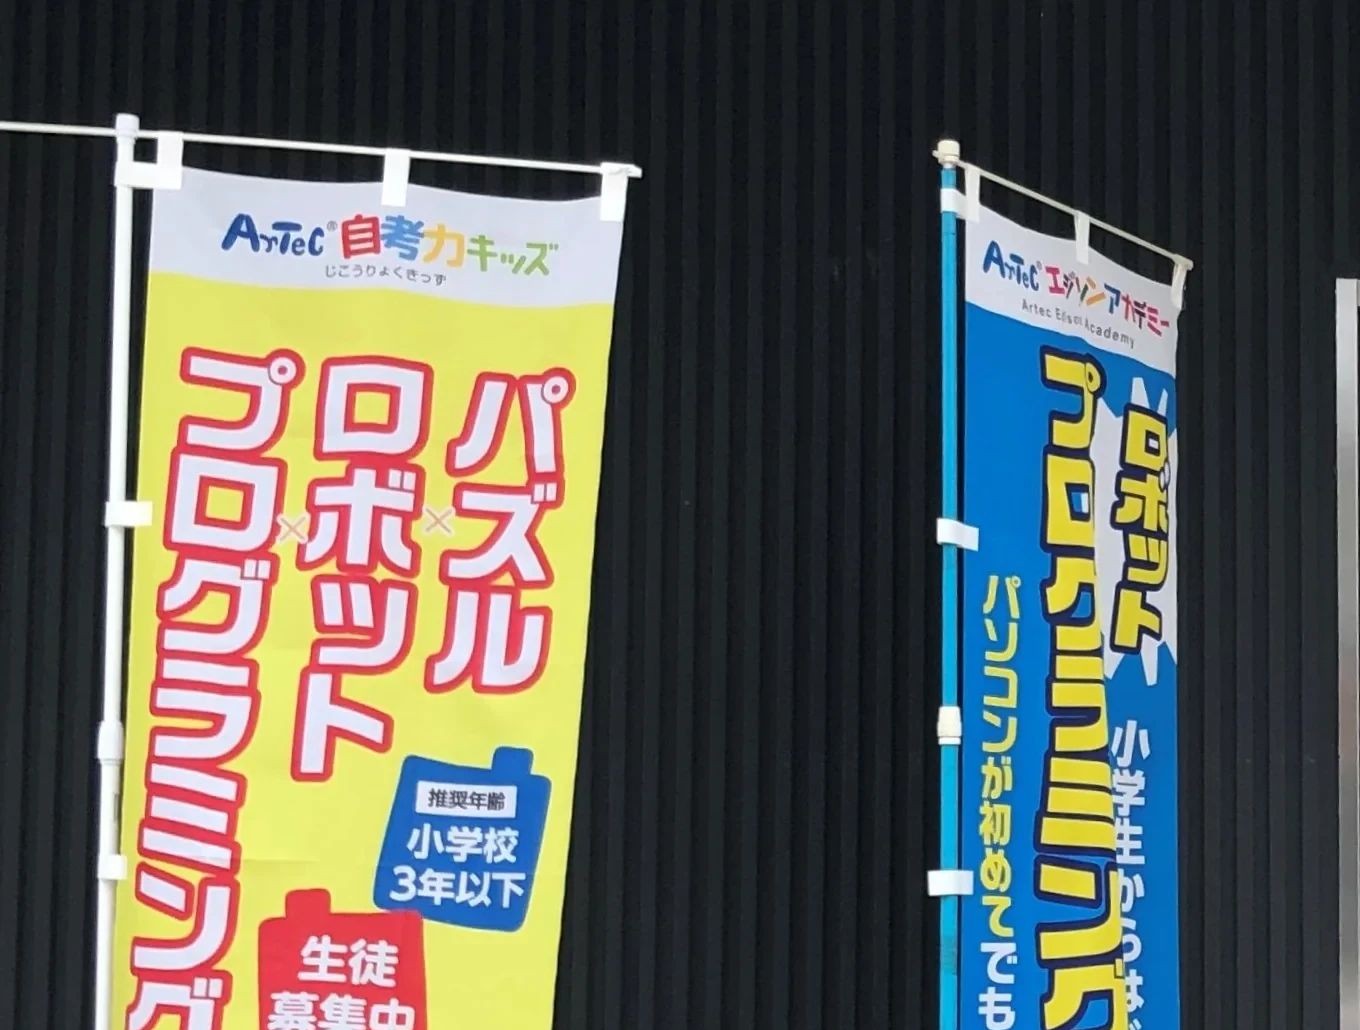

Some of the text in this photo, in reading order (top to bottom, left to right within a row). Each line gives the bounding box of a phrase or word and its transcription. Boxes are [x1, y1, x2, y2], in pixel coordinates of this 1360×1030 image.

[340, 213, 559, 277] 自考力キッズ
[324, 263, 448, 287] じこうりょくきっず
[1045, 265, 1170, 337] エジソンアカデミー
[1022, 298, 1052, 318] Artec
[424, 368, 576, 695] パズル
[1110, 403, 1171, 656] ロボット
[291, 355, 433, 783] ロボット
[426, 788, 506, 812] 推奨年齢
[406, 823, 519, 864] 小学校
[389, 865, 526, 908] 3年以下
[298, 934, 400, 988] 生徒
